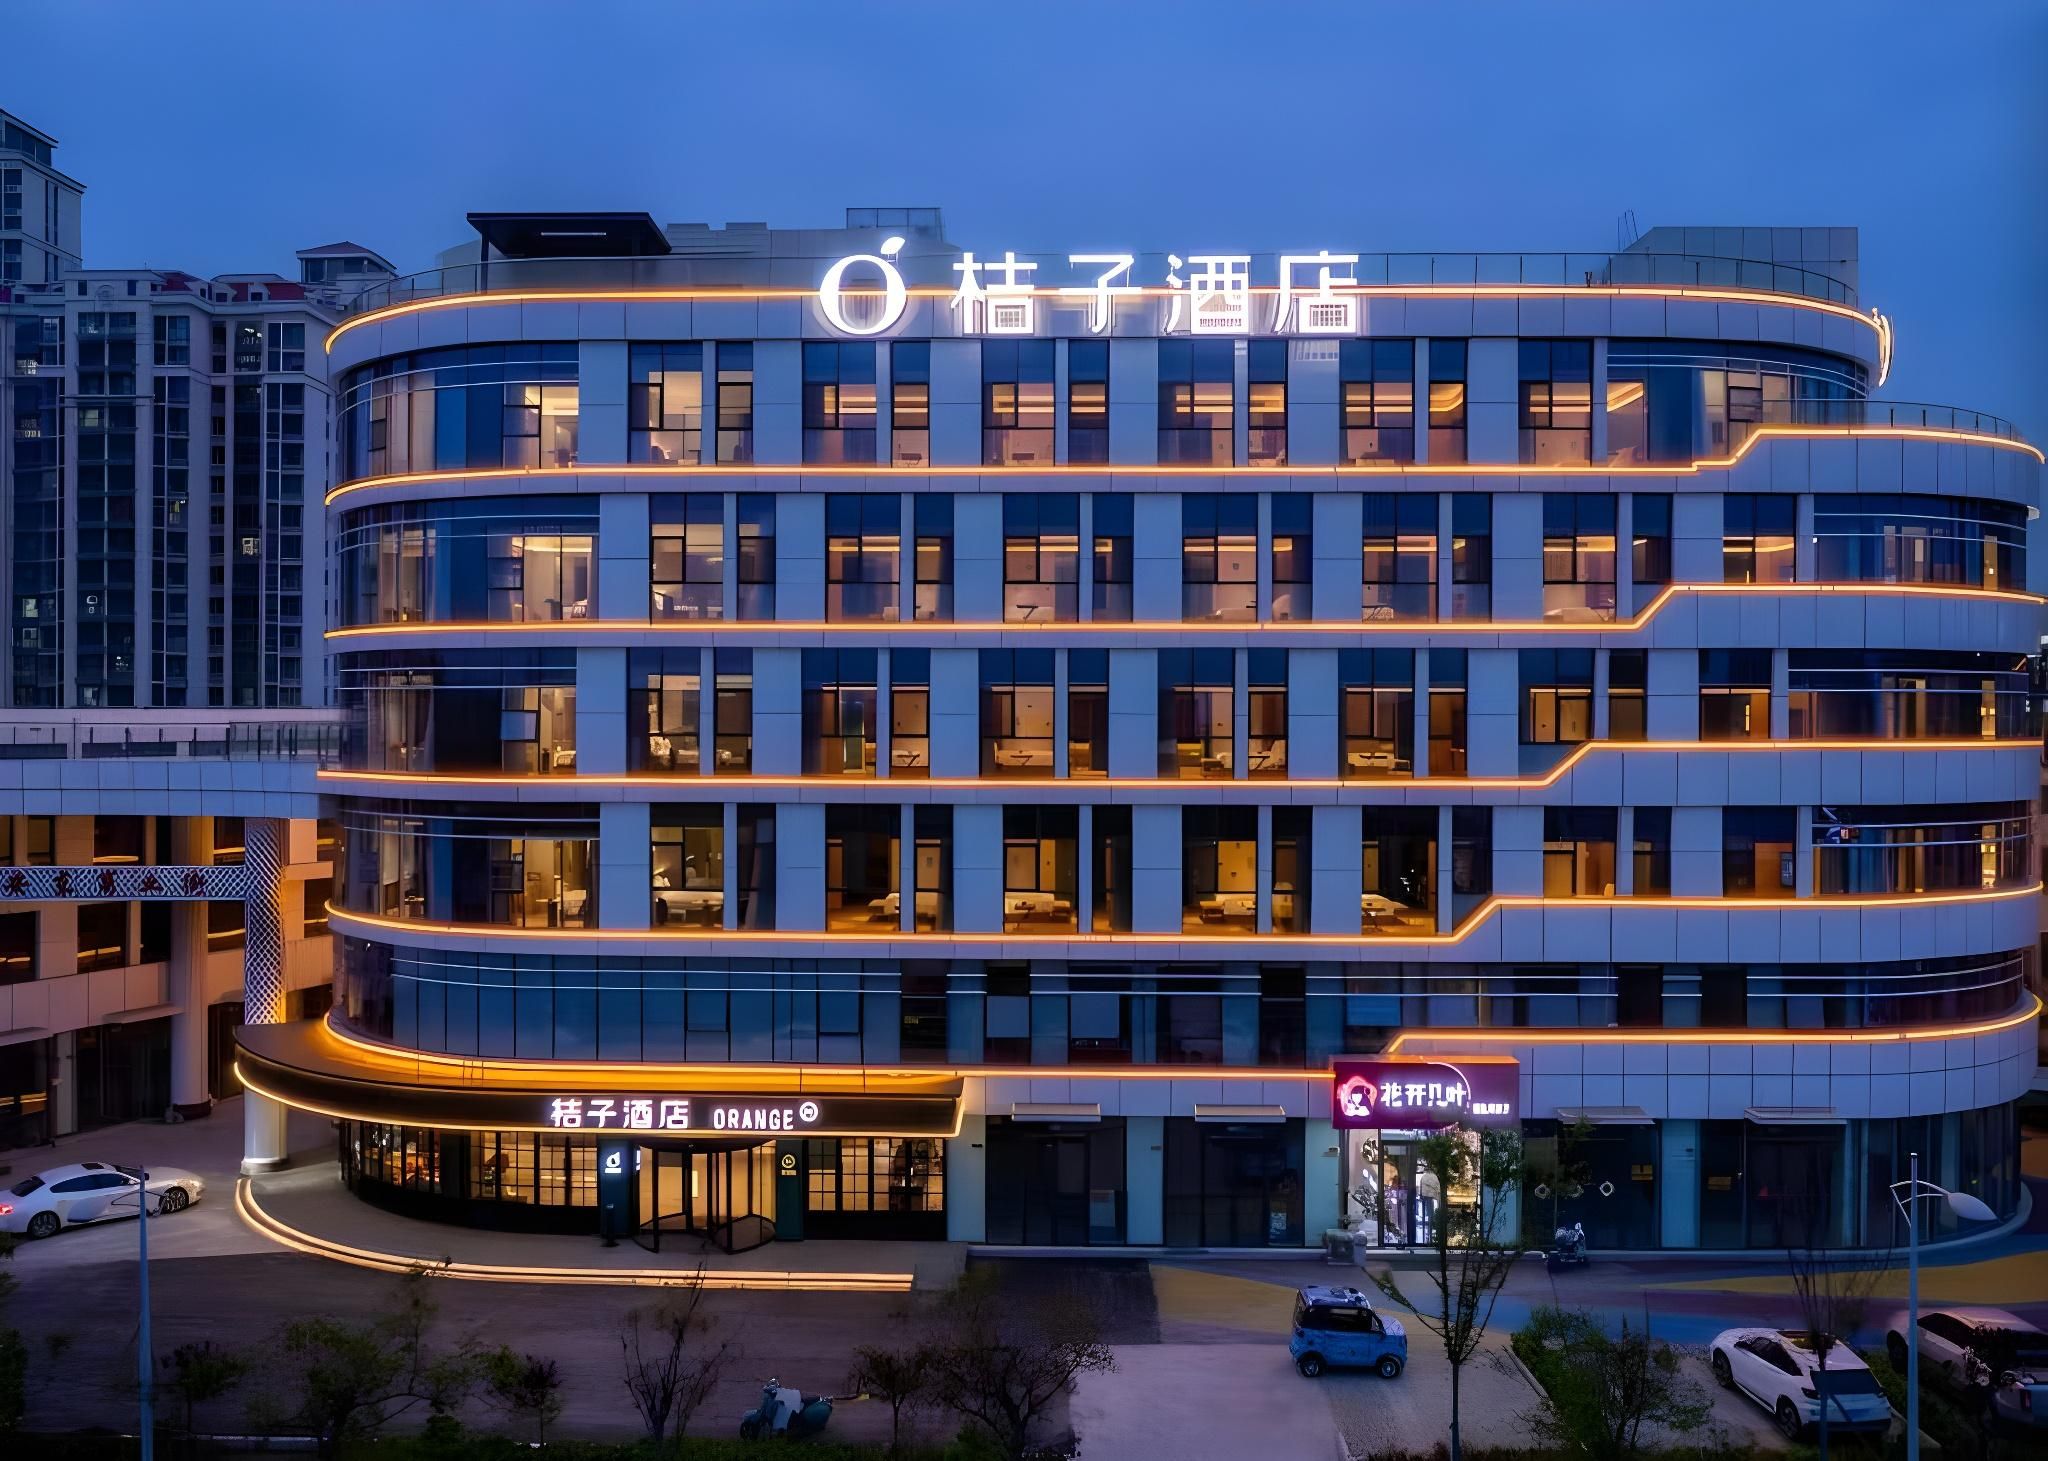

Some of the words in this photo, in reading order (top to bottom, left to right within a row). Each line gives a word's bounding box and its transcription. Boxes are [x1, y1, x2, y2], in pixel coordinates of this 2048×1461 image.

[952, 250, 1359, 335] 桔子酒店
[550, 1098, 689, 1128] 桔子酒店
[713, 1109, 794, 1130] ORANGE
